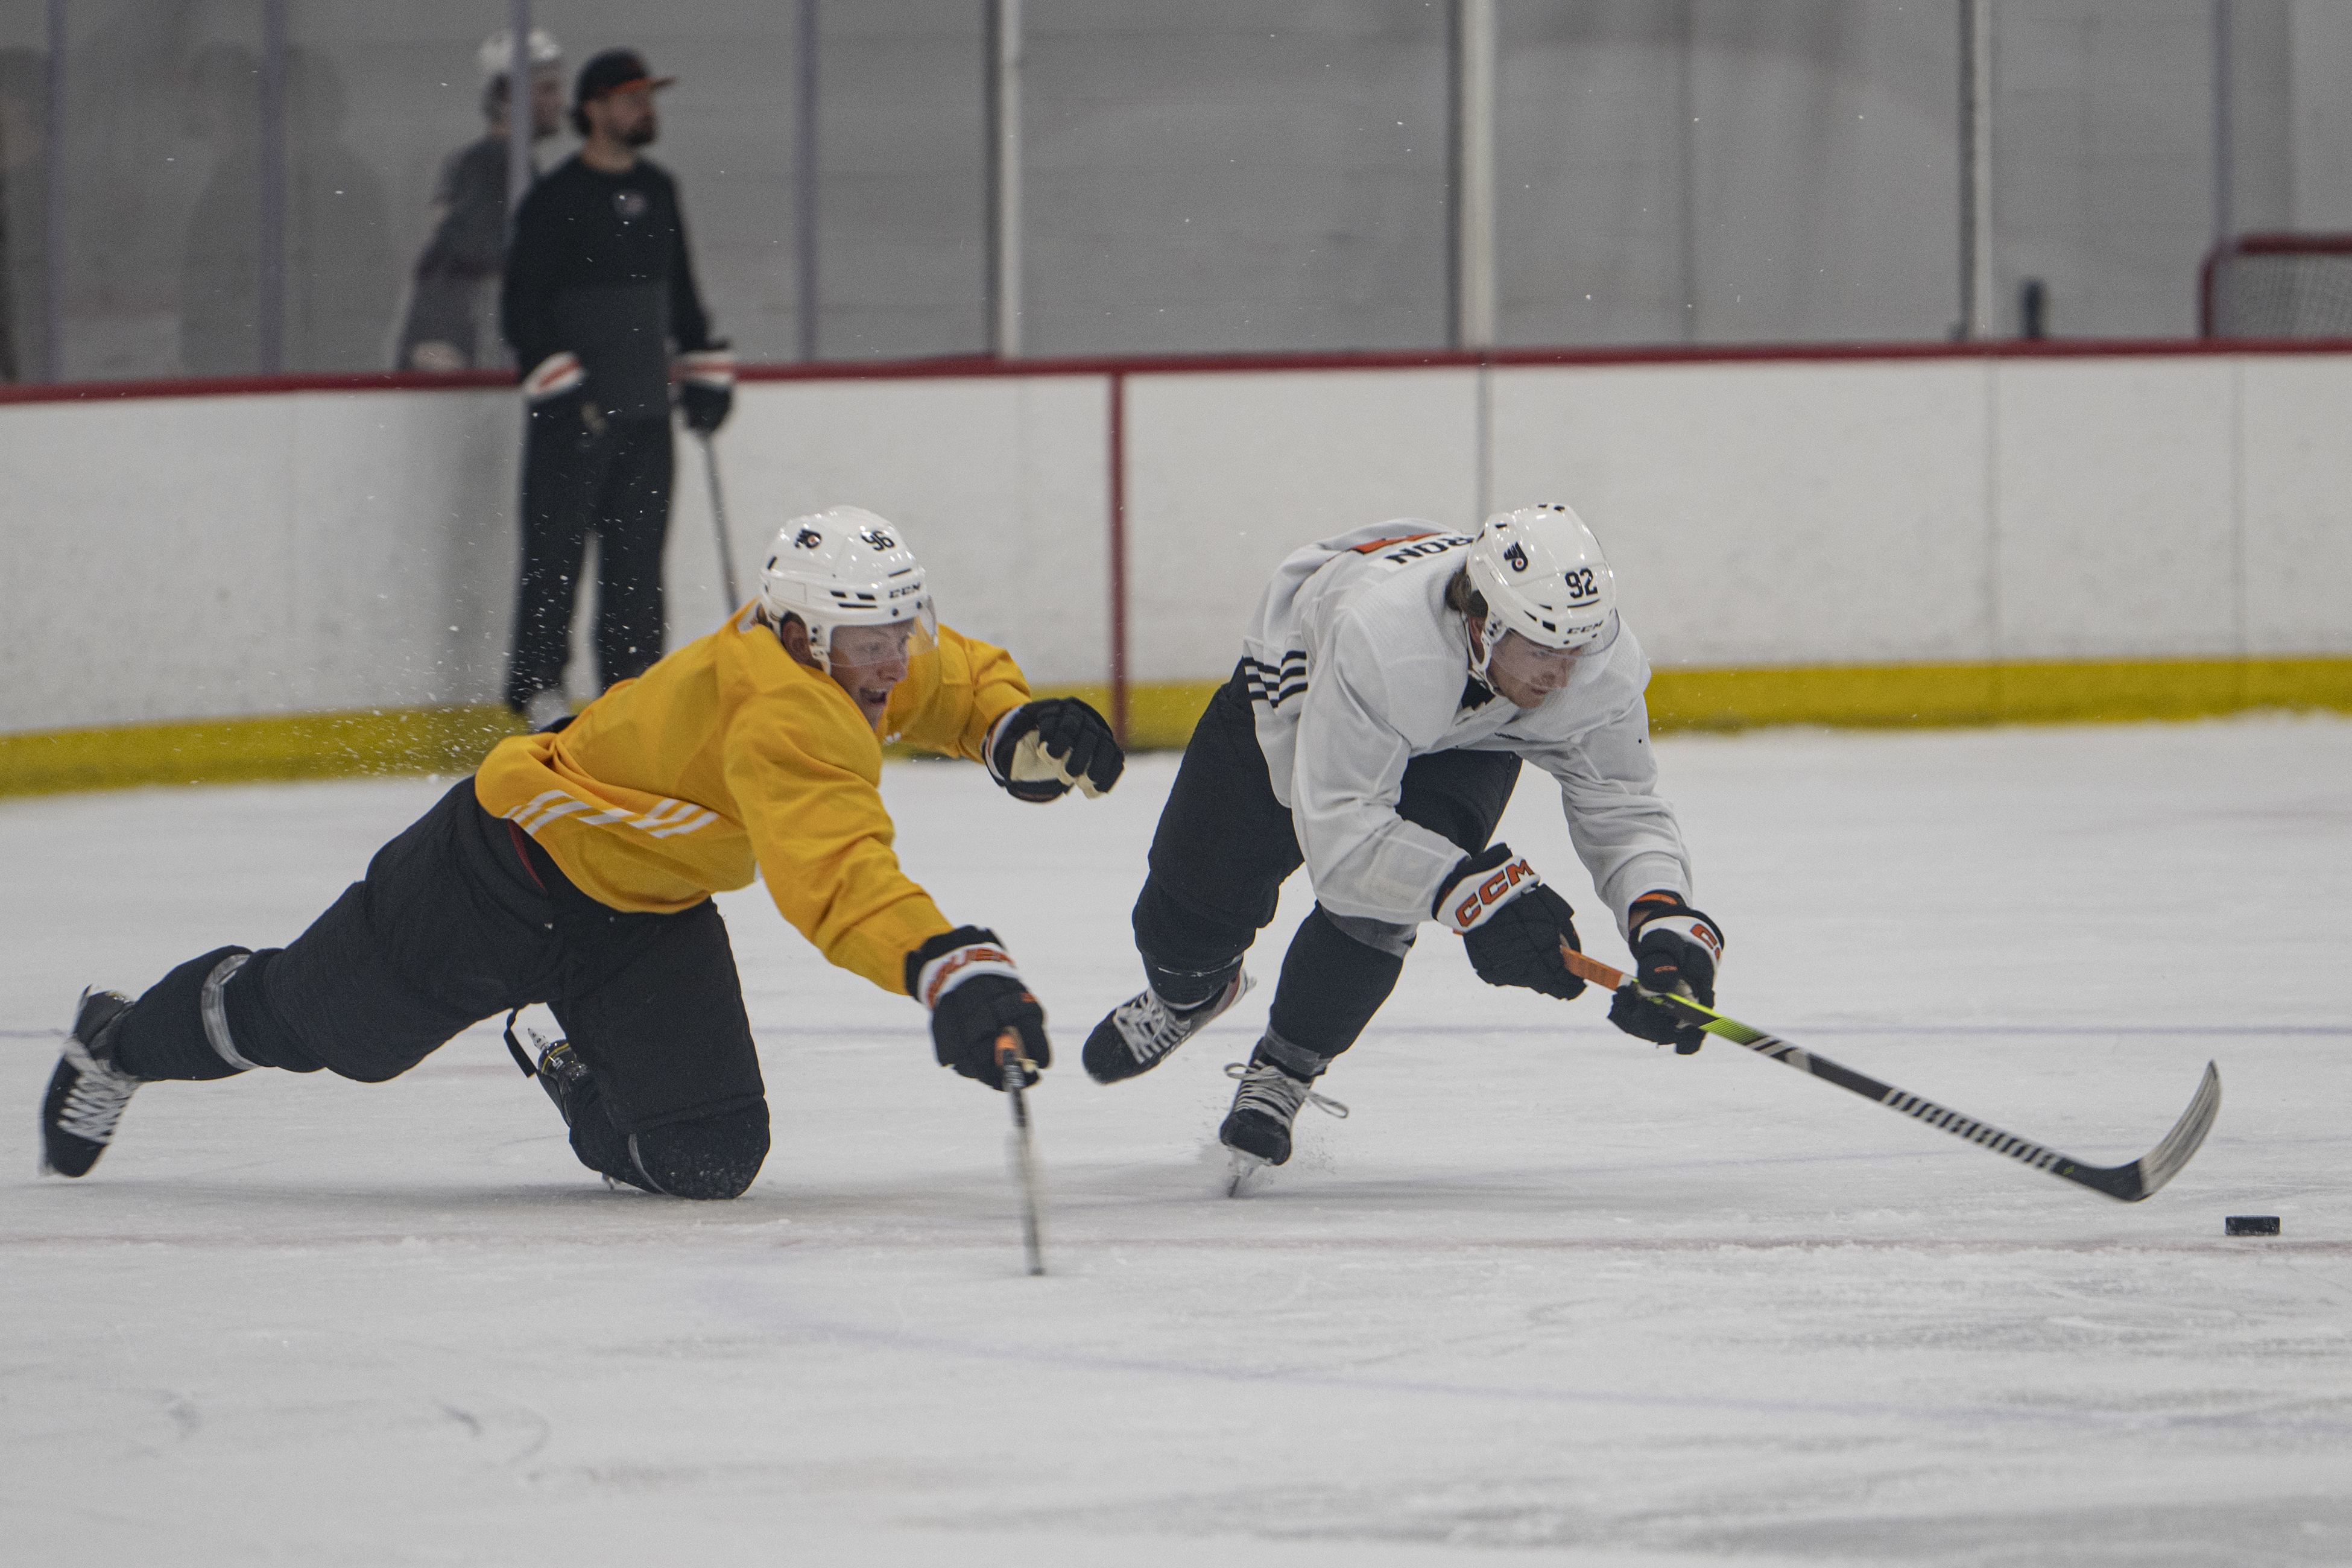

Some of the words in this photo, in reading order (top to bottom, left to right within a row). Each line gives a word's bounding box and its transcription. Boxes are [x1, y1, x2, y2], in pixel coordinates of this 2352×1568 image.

[860, 530, 895, 551] 96
[889, 582, 921, 598] CCM
[1565, 568, 1598, 599] 92
[1567, 620, 1604, 634] CCM
[1455, 859, 1535, 928] CCM
